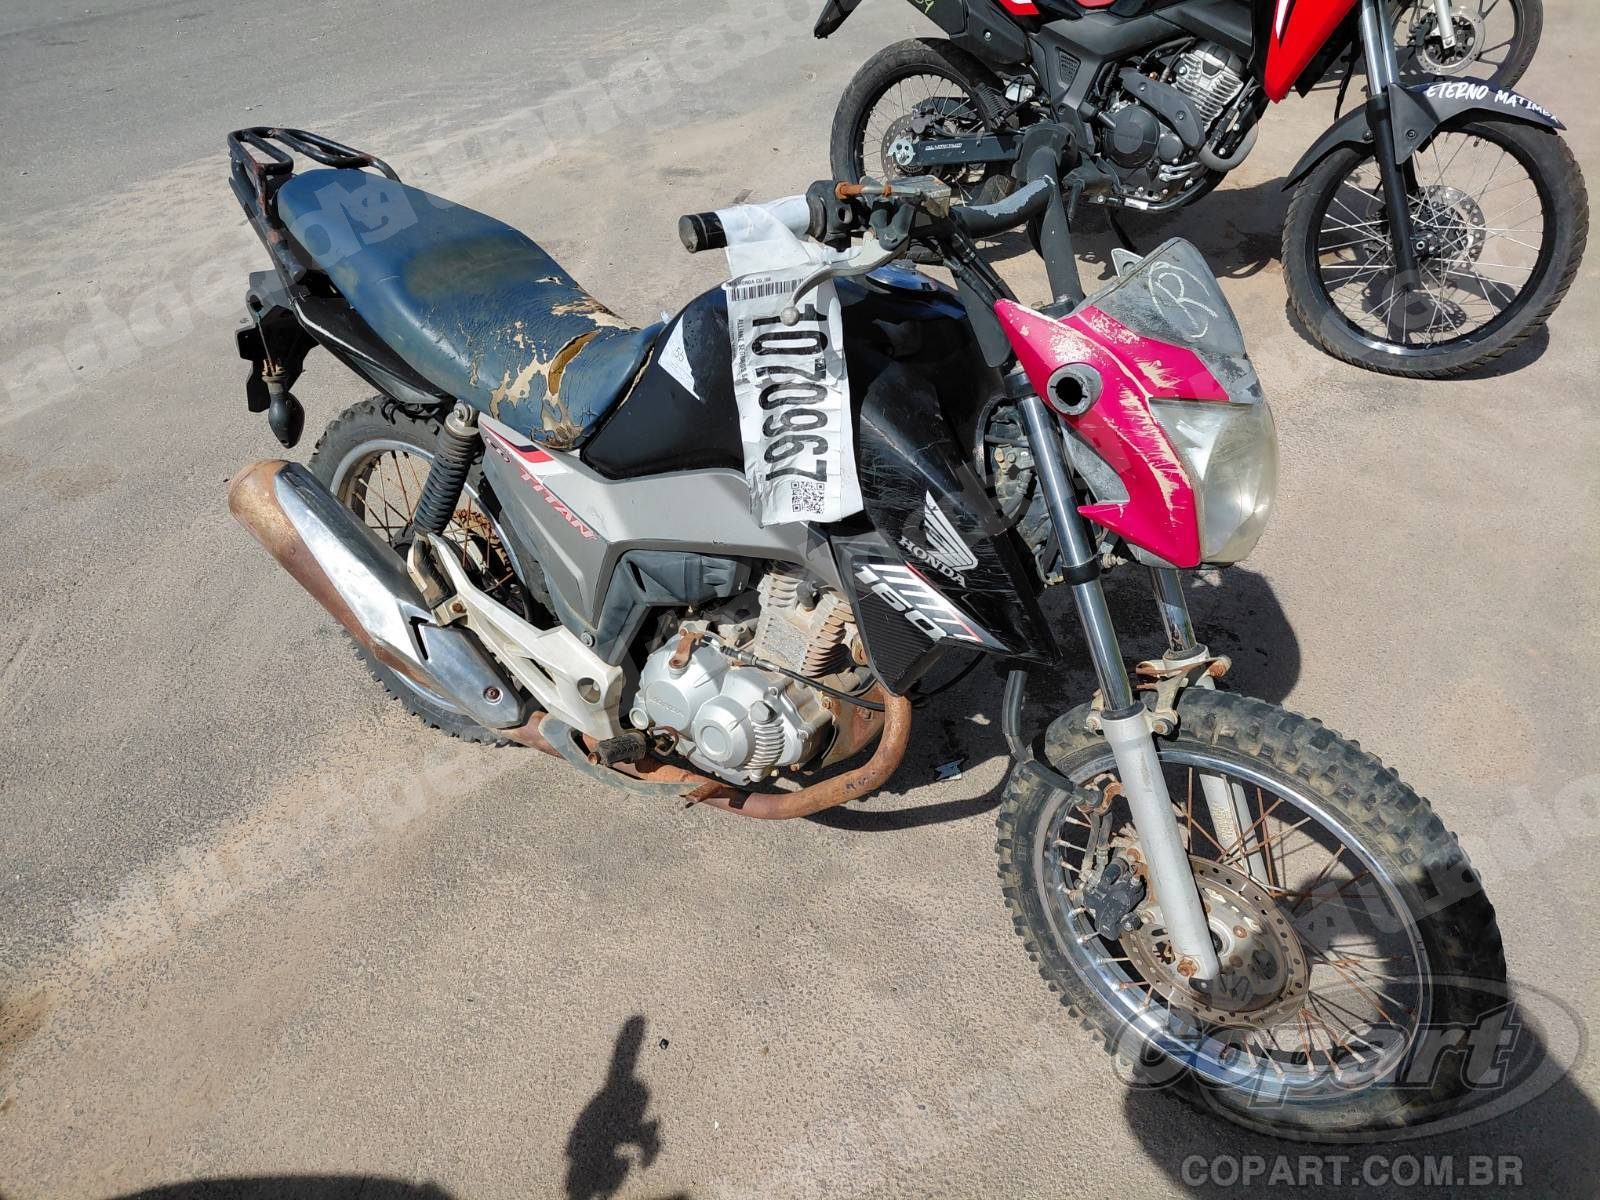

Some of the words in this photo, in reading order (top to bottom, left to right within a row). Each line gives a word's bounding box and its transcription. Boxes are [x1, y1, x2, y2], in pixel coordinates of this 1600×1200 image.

[1426, 81, 1489, 101] ETERNO
[752, 303, 829, 484] 1070967
[517, 462, 599, 541] TITAN
[899, 536, 968, 589] HONDA
[854, 564, 948, 643] 160
